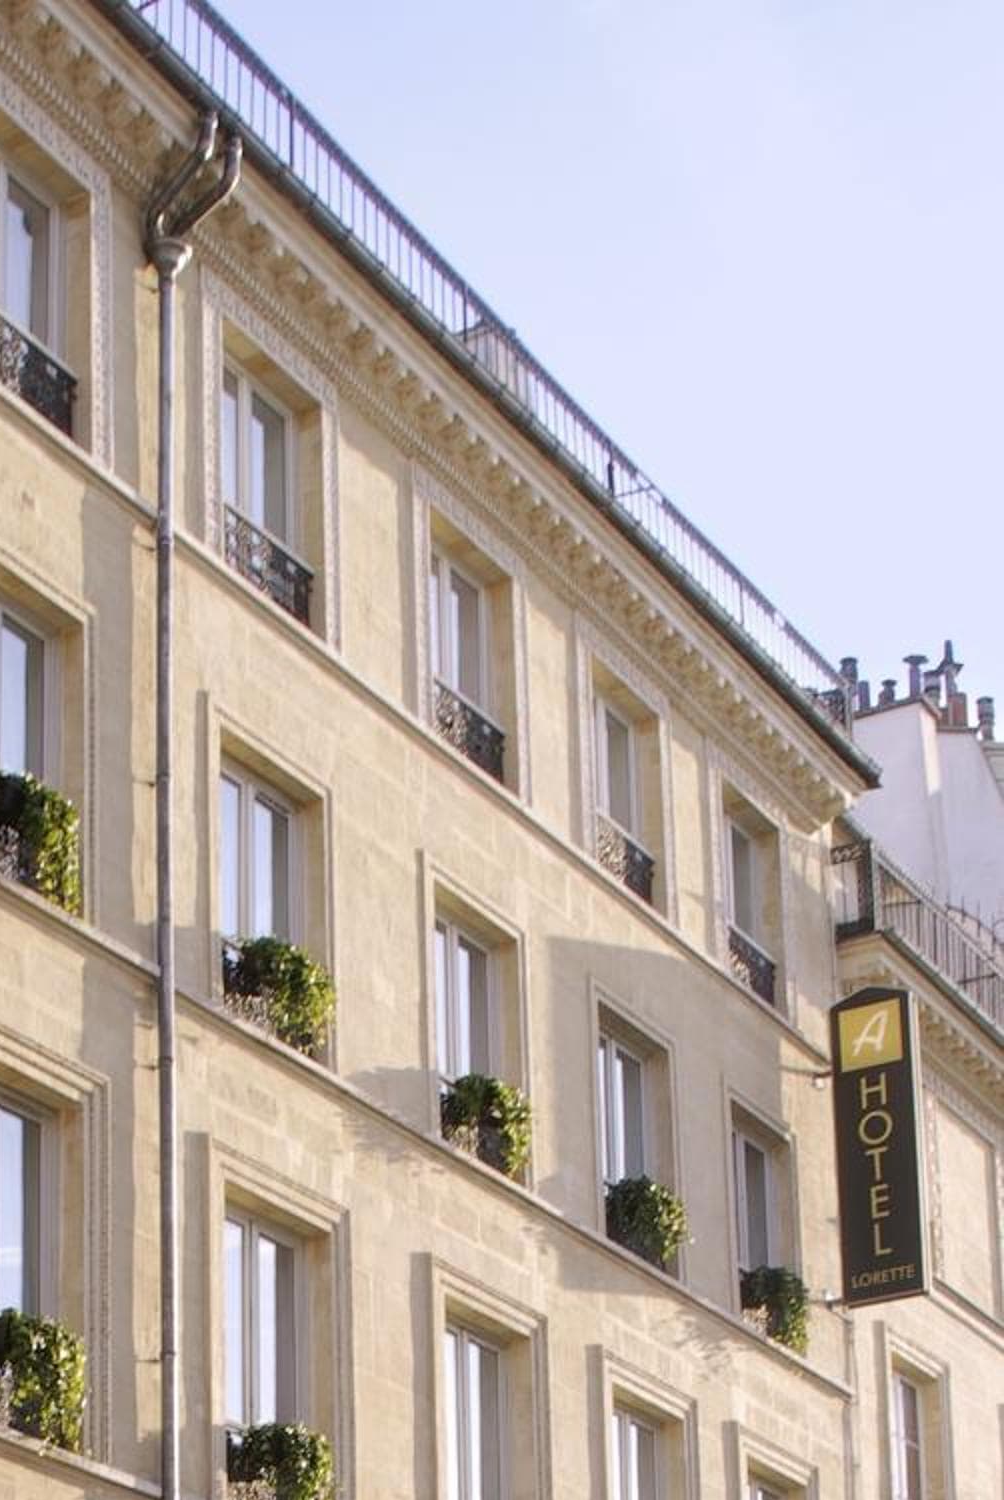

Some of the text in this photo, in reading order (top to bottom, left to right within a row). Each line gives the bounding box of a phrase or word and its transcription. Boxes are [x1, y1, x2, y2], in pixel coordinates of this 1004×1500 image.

[851, 1009, 888, 1057] A
[857, 1071, 894, 1257] HOTEL
[851, 1264, 917, 1289] LORETTE
